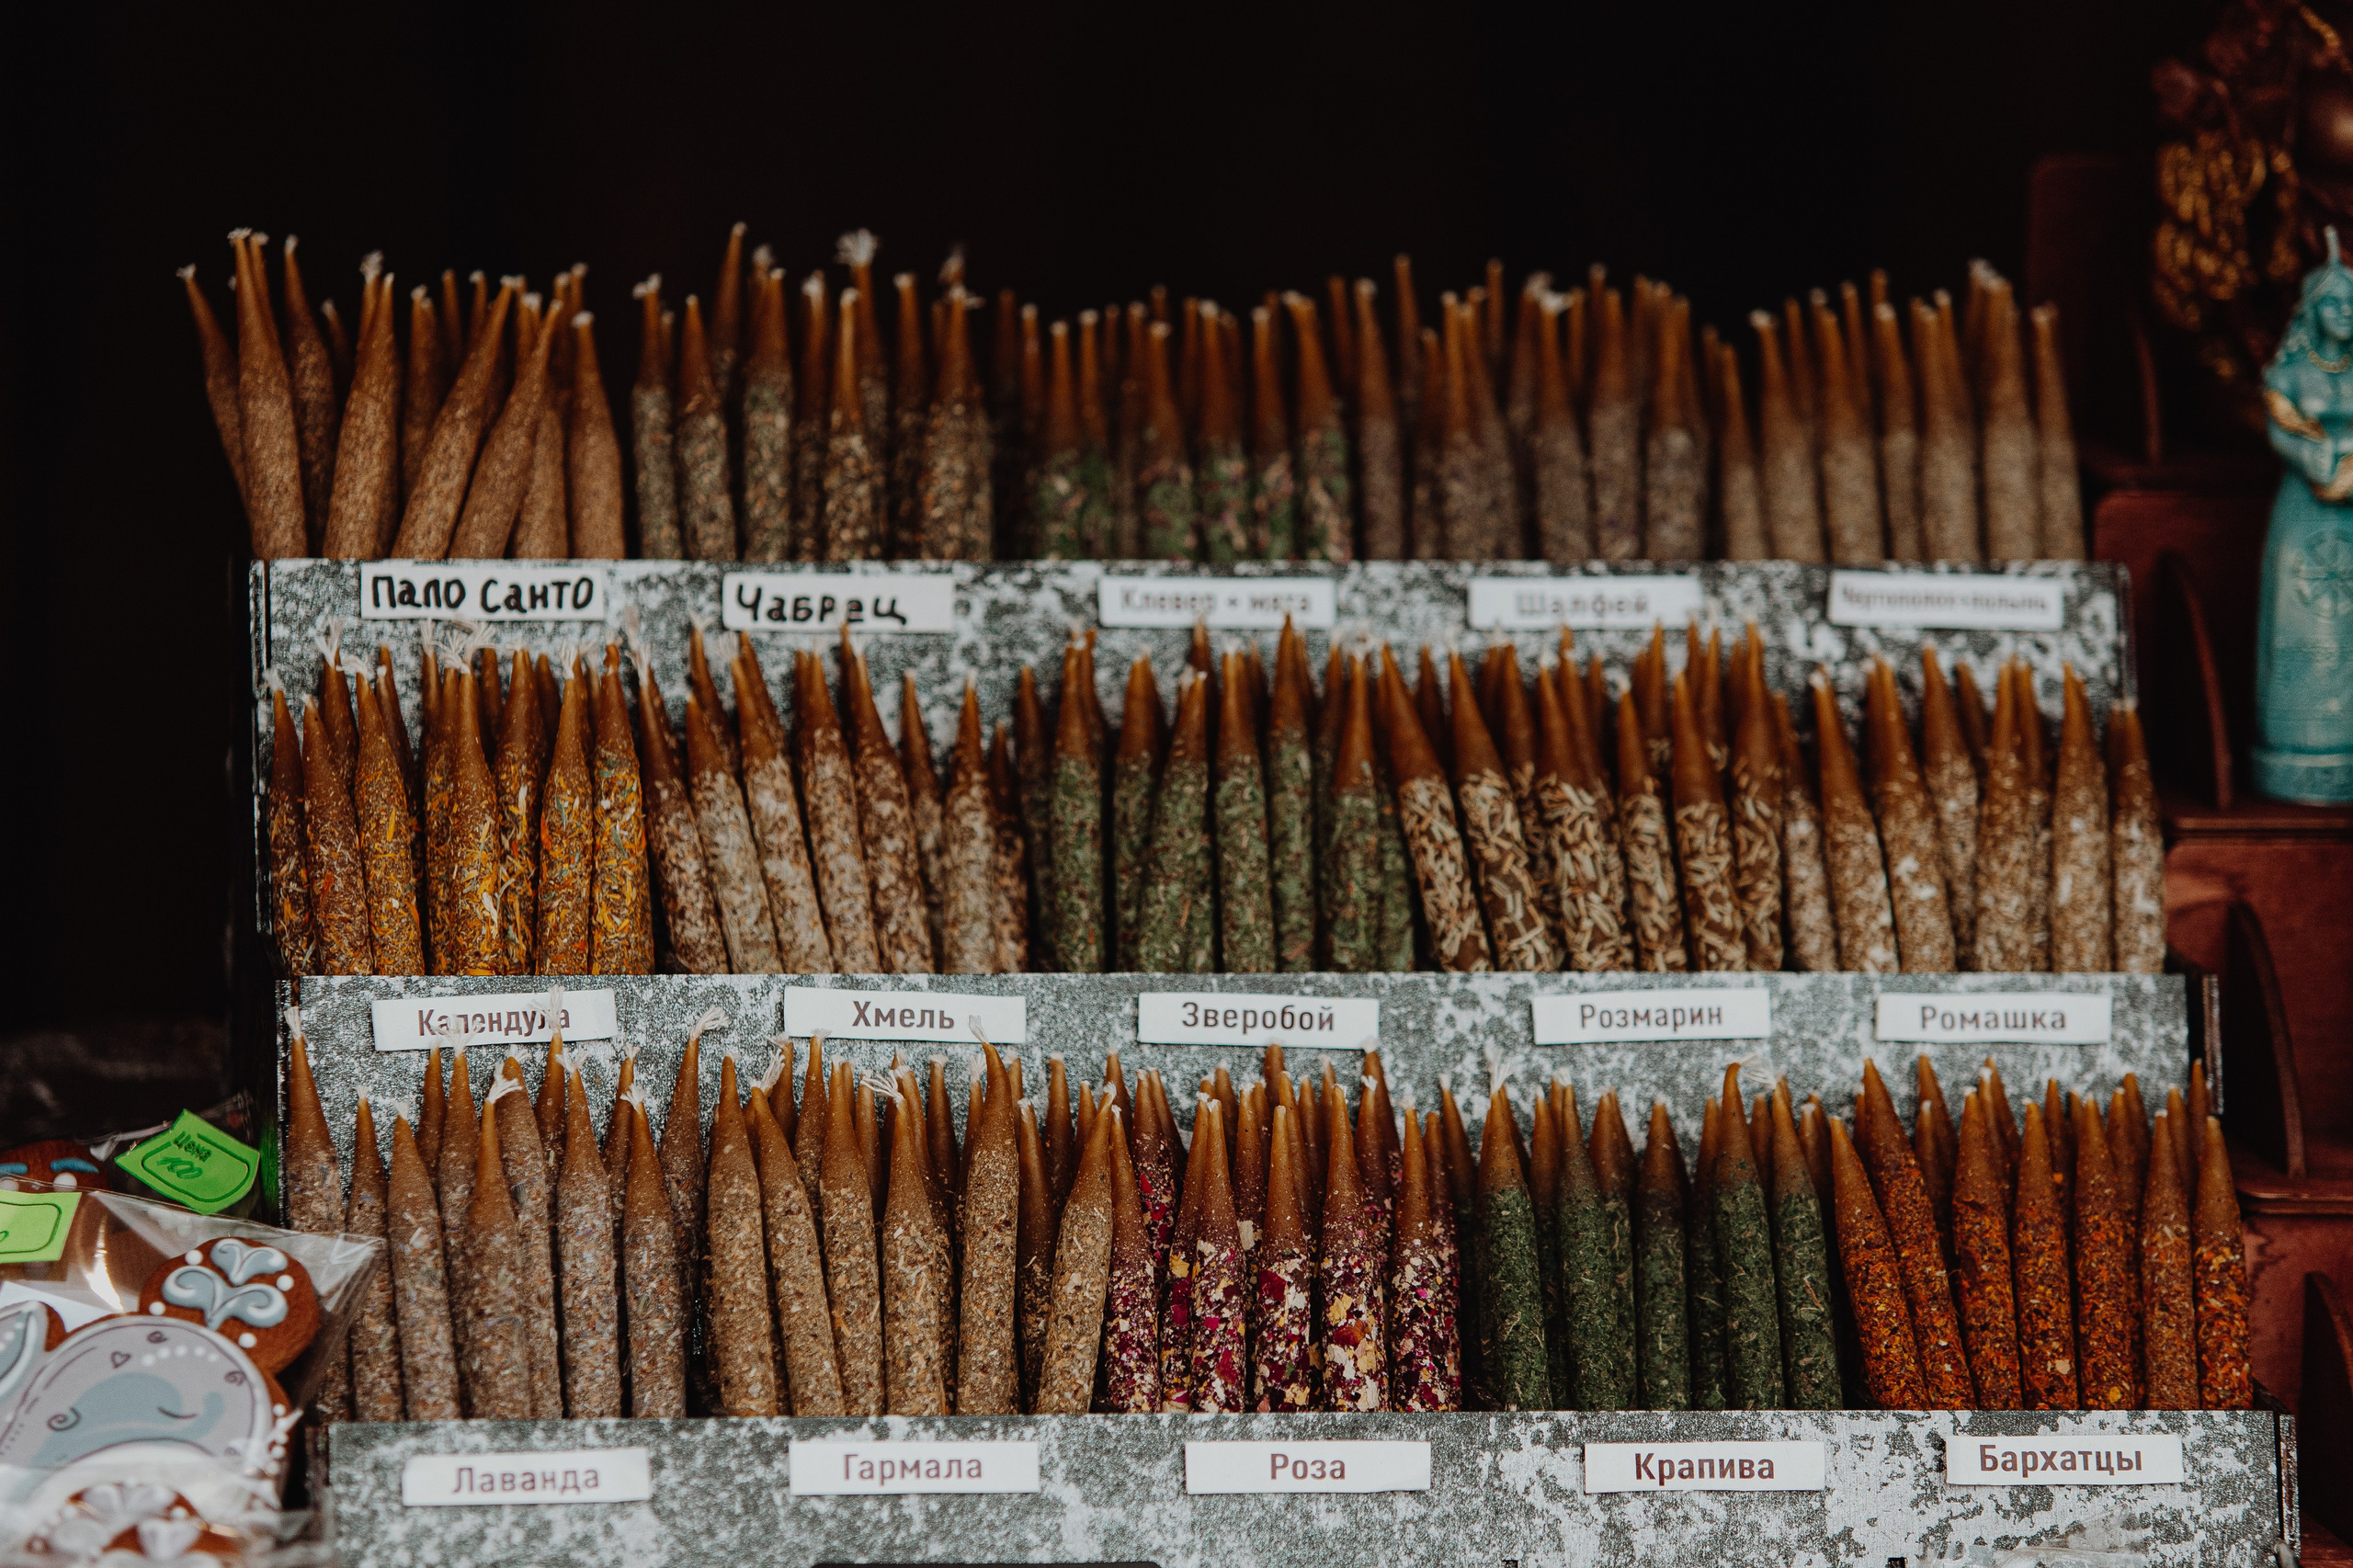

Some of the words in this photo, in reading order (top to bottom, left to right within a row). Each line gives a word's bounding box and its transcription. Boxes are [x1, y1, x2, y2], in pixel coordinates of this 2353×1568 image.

[371, 575, 467, 608] Пало
[480, 576, 595, 613] Санто
[737, 584, 907, 626] Чабрец
[851, 1000, 956, 1029] Хмель
[1181, 1002, 1335, 1035] Зверобой
[1579, 1004, 1724, 1032] Розмарин
[1920, 1006, 2068, 1030] Ромашка
[843, 1453, 983, 1486] Гармала
[1270, 1452, 1347, 1481] Роза
[1634, 1452, 1776, 1487] Крапива
[1979, 1444, 2143, 1479] Бархатцы
[452, 1467, 600, 1495] Лаванда
